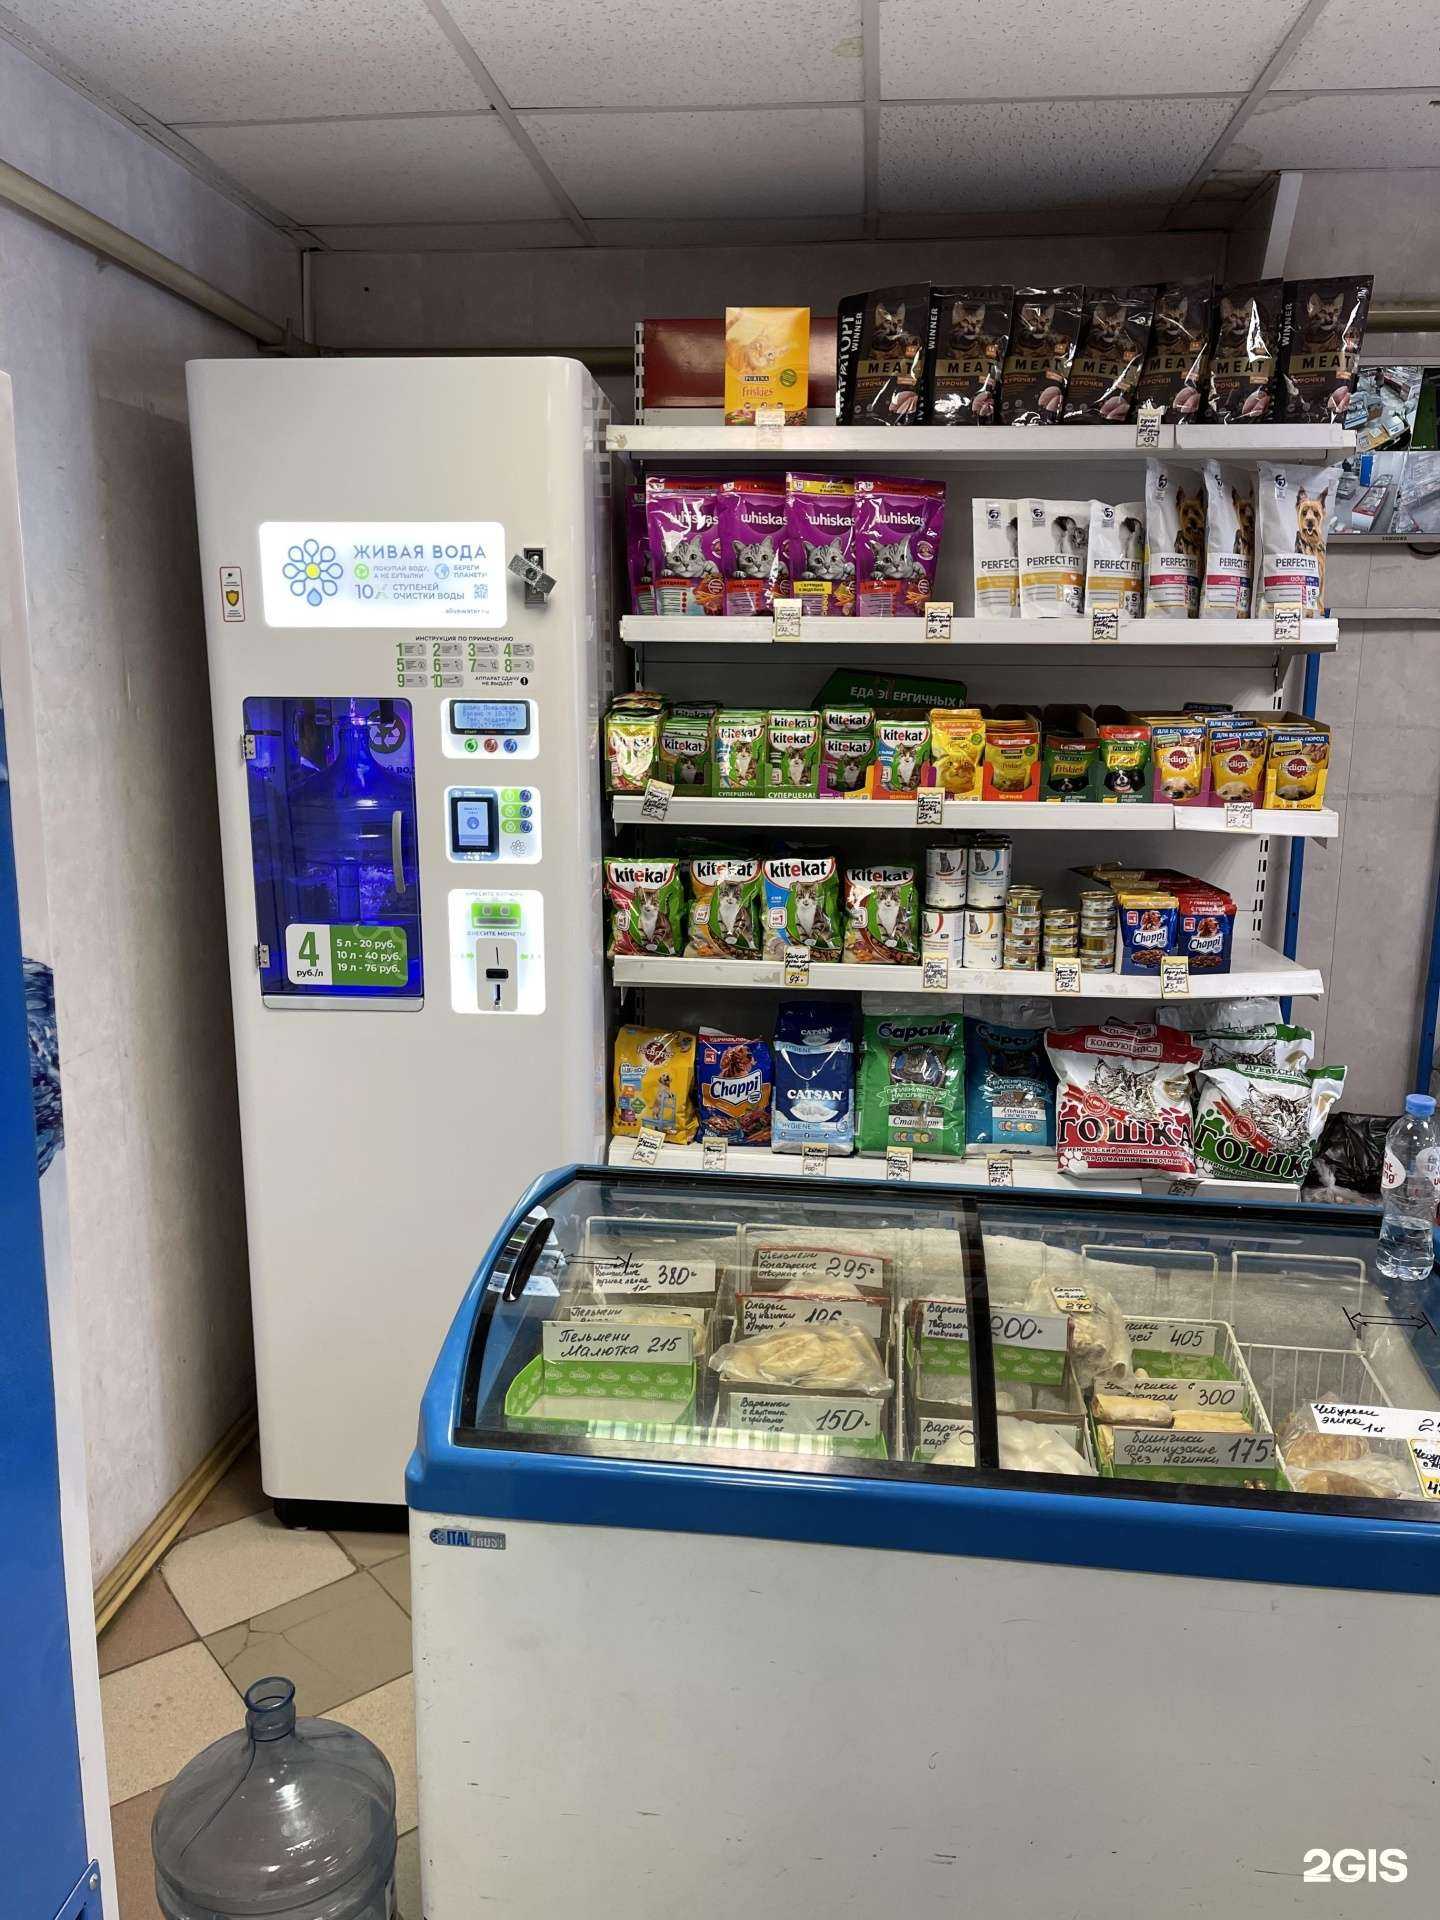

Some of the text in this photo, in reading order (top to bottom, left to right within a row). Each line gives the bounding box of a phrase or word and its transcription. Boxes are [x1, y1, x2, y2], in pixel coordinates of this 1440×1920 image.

[851, 311, 863, 352] WINNER
[928, 308, 939, 350] WINNER
[1281, 303, 1293, 347] WINNER
[947, 361, 993, 373] MEAT
[1082, 361, 1119, 375] MEA
[1150, 356, 1195, 370] MEAT
[1216, 360, 1265, 374] MEAT
[1302, 356, 1351, 369] MEAT
[353, 544, 487, 561] ЖИВАЯ ВОДА
[1026, 556, 1079, 567] PERFECT FIT
[1094, 560, 1129, 570] PERFECT
[1276, 558, 1308, 568] PERFECT
[354, 583, 439, 599] 10 СТУПЕНЕЙ
[393, 592, 465, 600] ОЧИСТКИ ВОДЫ
[396, 643, 403, 657] 1
[432, 643, 441, 657] 2
[468, 643, 476, 657] 3
[503, 643, 512, 657] 4
[396, 658, 405, 672] 5
[433, 658, 441, 672] 6
[468, 658, 477, 672] 7
[504, 659, 513, 672] 8
[397, 673, 405, 688] 9
[431, 673, 443, 688] 10
[850, 686, 875, 698] ЕДА
[877, 688, 955, 707] ЭЕРГИЧНЫХ
[774, 717, 814, 728] kitekat
[828, 713, 867, 726] kitekat
[773, 731, 811, 744] kitekat
[883, 728, 923, 742] kitekat
[664, 739, 702, 752] kitekat
[827, 740, 867, 753] kitekat
[768, 792, 816, 800] СУПЕРЦЕНА!
[769, 861, 827, 878] kitekat
[851, 869, 909, 882] kitekat
[336, 939, 343, 947] 5
[360, 940, 371, 948] 20
[374, 940, 396, 950] руб.
[1134, 930, 1165, 946] Chappi
[1189, 937, 1221, 952] Chappi
[298, 932, 320, 967] 4
[336, 951, 347, 959] 10
[365, 951, 378, 960] 40
[380, 952, 402, 962] руб.
[297, 969, 324, 978] руб./л
[337, 963, 348, 971] 19
[364, 964, 377, 972] 76
[379, 964, 401, 975] руб.
[801, 1026, 833, 1036] CATSAN
[710, 1076, 759, 1099] Chappi
[787, 1089, 844, 1101] CATSAN
[782, 1122, 812, 1130] HYGIENE
[1059, 1117, 1193, 1149] ГОШКА
[571, 1307, 622, 1317] Пельмени
[559, 1330, 631, 1343] Пельмени
[1170, 1330, 1205, 1347] 405
[561, 1345, 640, 1359] Малютка
[648, 1336, 683, 1354] 215
[1197, 1389, 1236, 1406] 300
